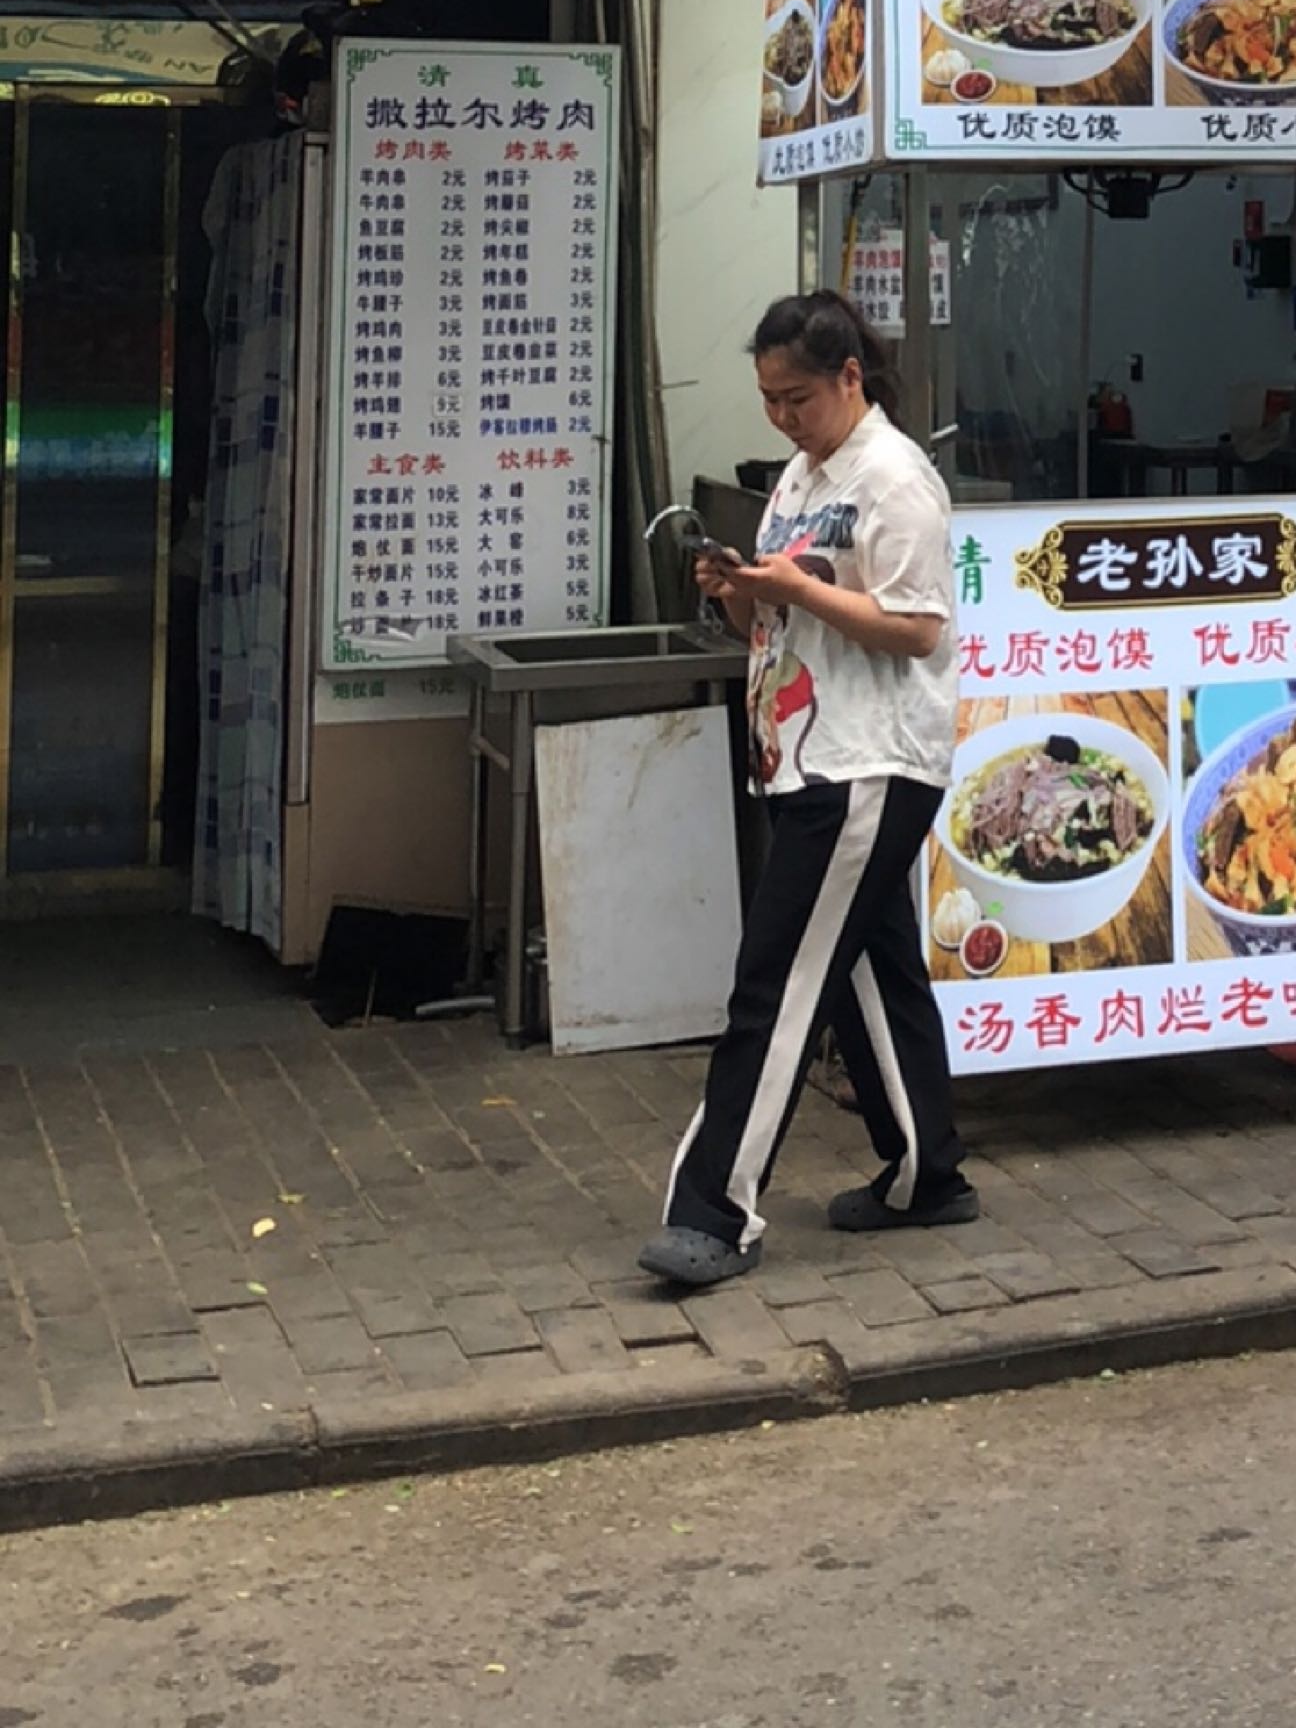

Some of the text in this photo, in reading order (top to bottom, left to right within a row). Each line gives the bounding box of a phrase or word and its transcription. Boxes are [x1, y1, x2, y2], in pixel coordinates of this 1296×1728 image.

[417, 64, 543, 88] 清真
[365, 96, 595, 131] 撒拉尔烤肉
[957, 112, 1120, 143] 优质泡馍
[374, 139, 578, 161] 烤肉类 烤菜类
[442, 169, 466, 186] 2元
[574, 169, 596, 186] 2元
[441, 194, 465, 211] 2元
[573, 193, 596, 210] 2元
[441, 220, 464, 236] 2元
[572, 218, 595, 235] 2元
[440, 245, 464, 261] 2元
[571, 243, 595, 260] 2元
[439, 270, 462, 287] 2元
[570, 267, 594, 284] 2元
[439, 295, 462, 312] 3元
[570, 291, 593, 308] 3元
[439, 320, 462, 337] 3元
[570, 316, 593, 333] 2元
[438, 345, 462, 362] 3元
[569, 340, 593, 358] 2元
[569, 365, 592, 382] 2元
[429, 421, 461, 438] 15元
[367, 447, 575, 476] 主食类 饮料类
[428, 484, 460, 504] 10元
[567, 477, 591, 496] 3元
[427, 511, 460, 529] 13元
[427, 536, 459, 555] 15元
[426, 561, 459, 580] 15元
[566, 554, 589, 571] 3元
[1077, 533, 1270, 591] 老孙家
[957, 628, 1154, 678] 优质泡馍
